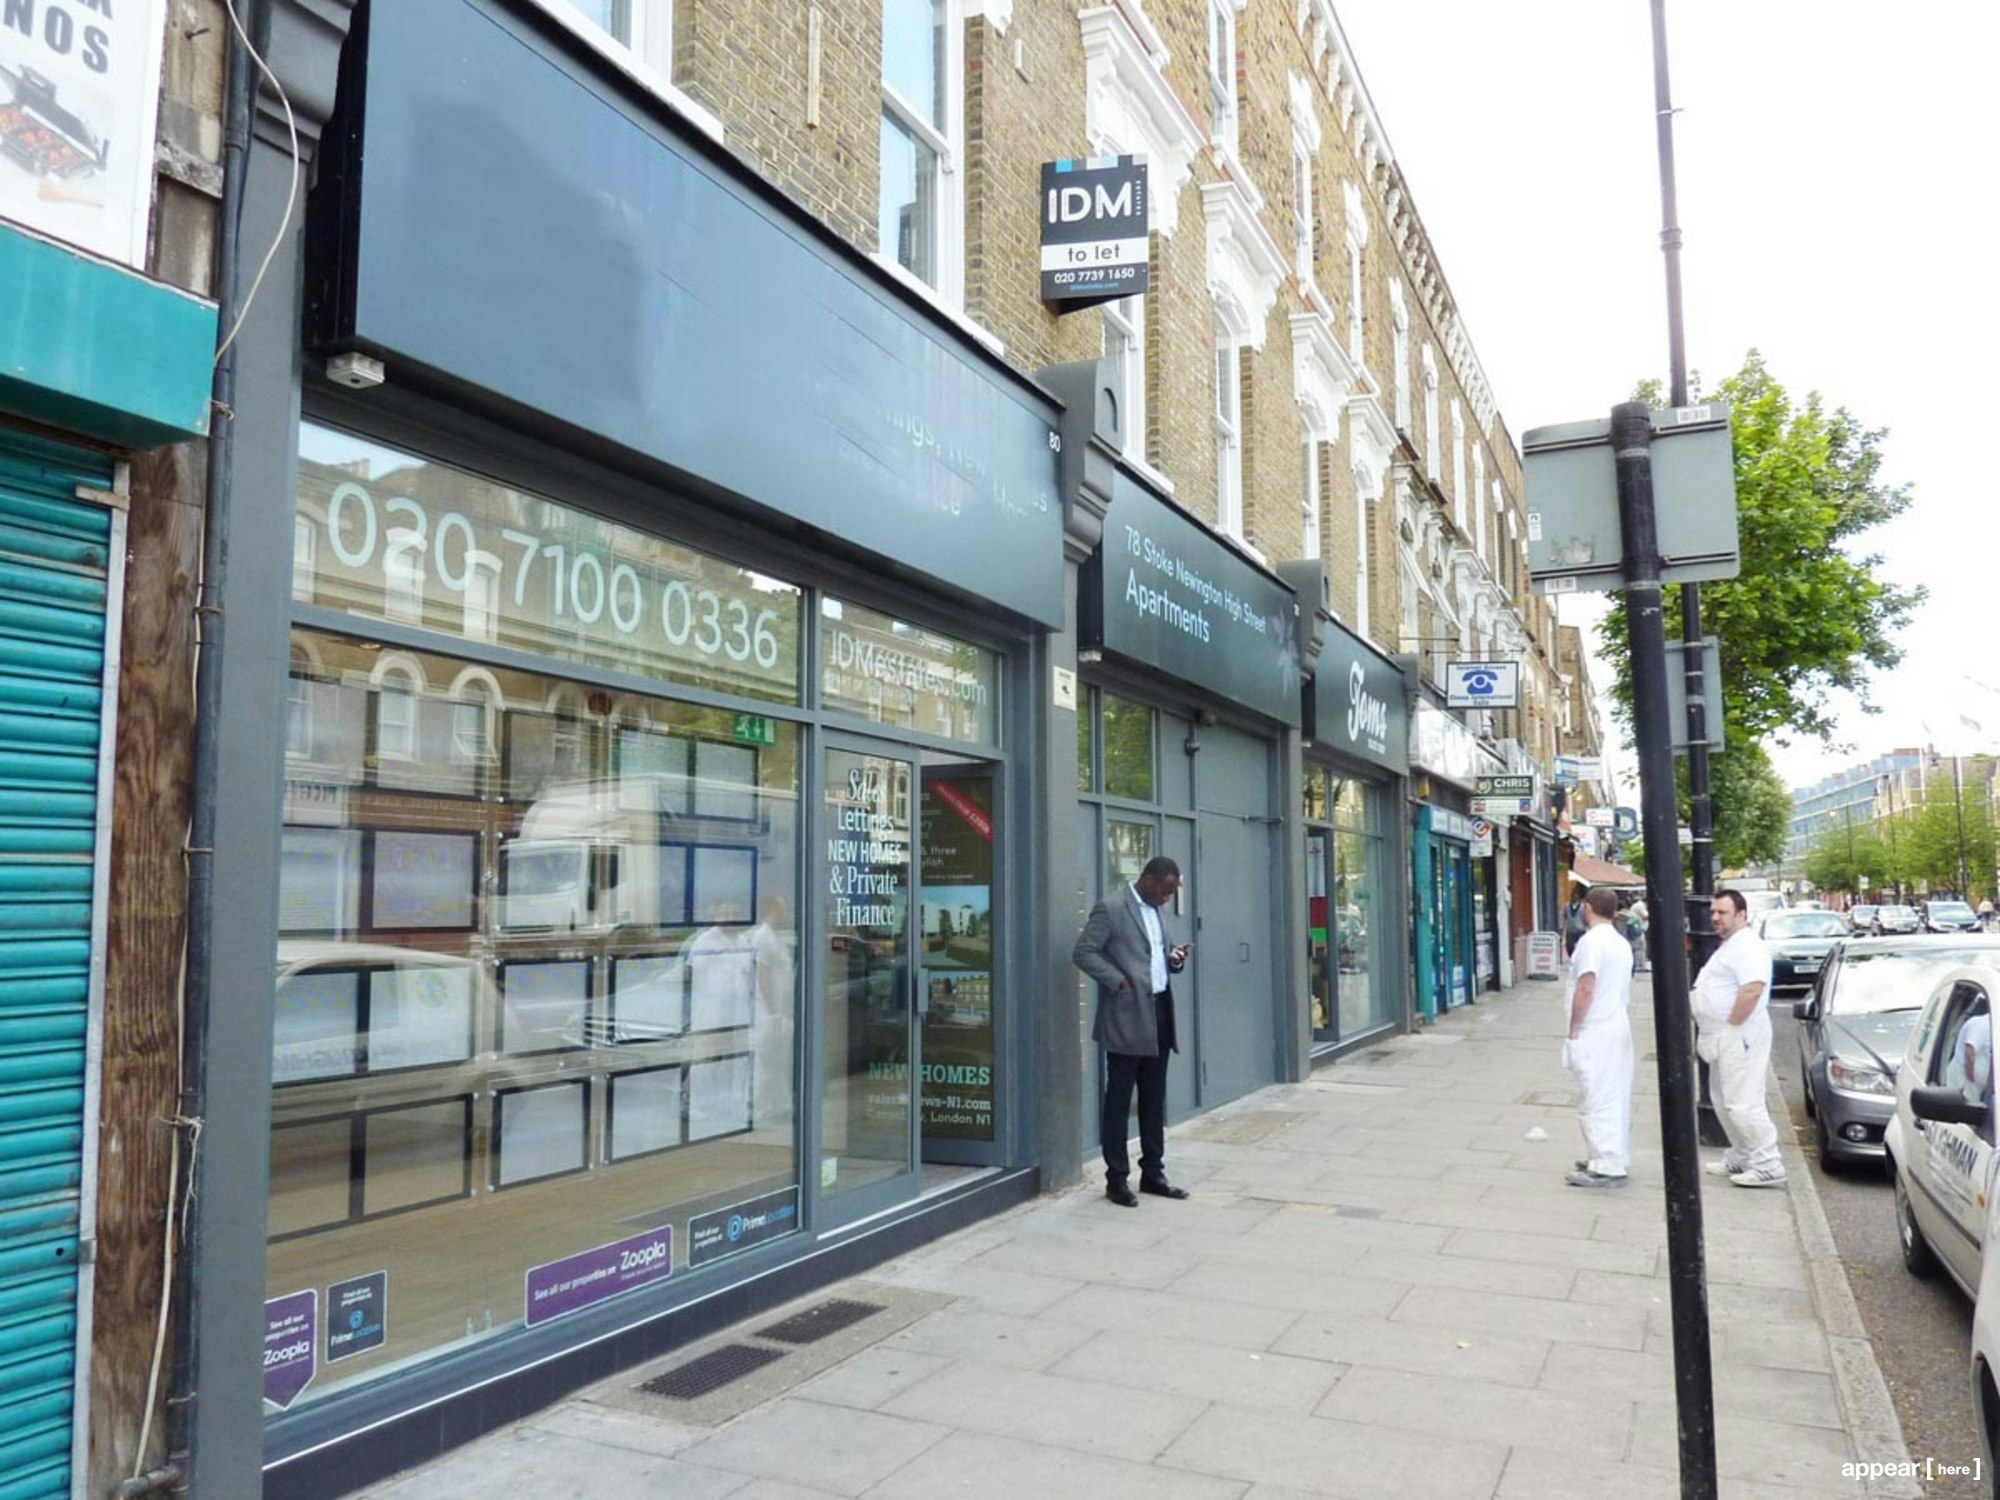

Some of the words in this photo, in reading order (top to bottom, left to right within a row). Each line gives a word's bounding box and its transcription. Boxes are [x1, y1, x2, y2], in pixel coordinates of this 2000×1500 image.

[1048, 181, 1132, 223] IDM
[1068, 248, 1087, 262] to
[1095, 244, 1120, 260] let
[1054, 273, 1075, 284] 020
[1078, 270, 1105, 282] 7739
[1108, 267, 1135, 279] 1650
[1049, 430, 1061, 453] 80
[328, 482, 475, 592] 020
[502, 529, 642, 633] 7100
[662, 580, 778, 668] 0336
[1125, 525, 1141, 556] 78
[1144, 537, 1174, 577] Stoke
[1176, 557, 1223, 605] Newington
[1224, 588, 1243, 622] High
[1126, 567, 1210, 643] Apartments
[1494, 778, 1530, 788] CHRIS
[838, 803, 894, 842] Lettings
[828, 840, 857, 862] NEW
[860, 840, 902, 866] HOMES
[829, 865, 844, 894] &
[847, 867, 898, 895] Private
[836, 898, 895, 927] Finance
[920, 1065, 990, 1086] HOMES
[931, 1111, 972, 1124] London
[621, 1240, 666, 1271] Zoopla
[263, 1341, 310, 1366] Zoopla
